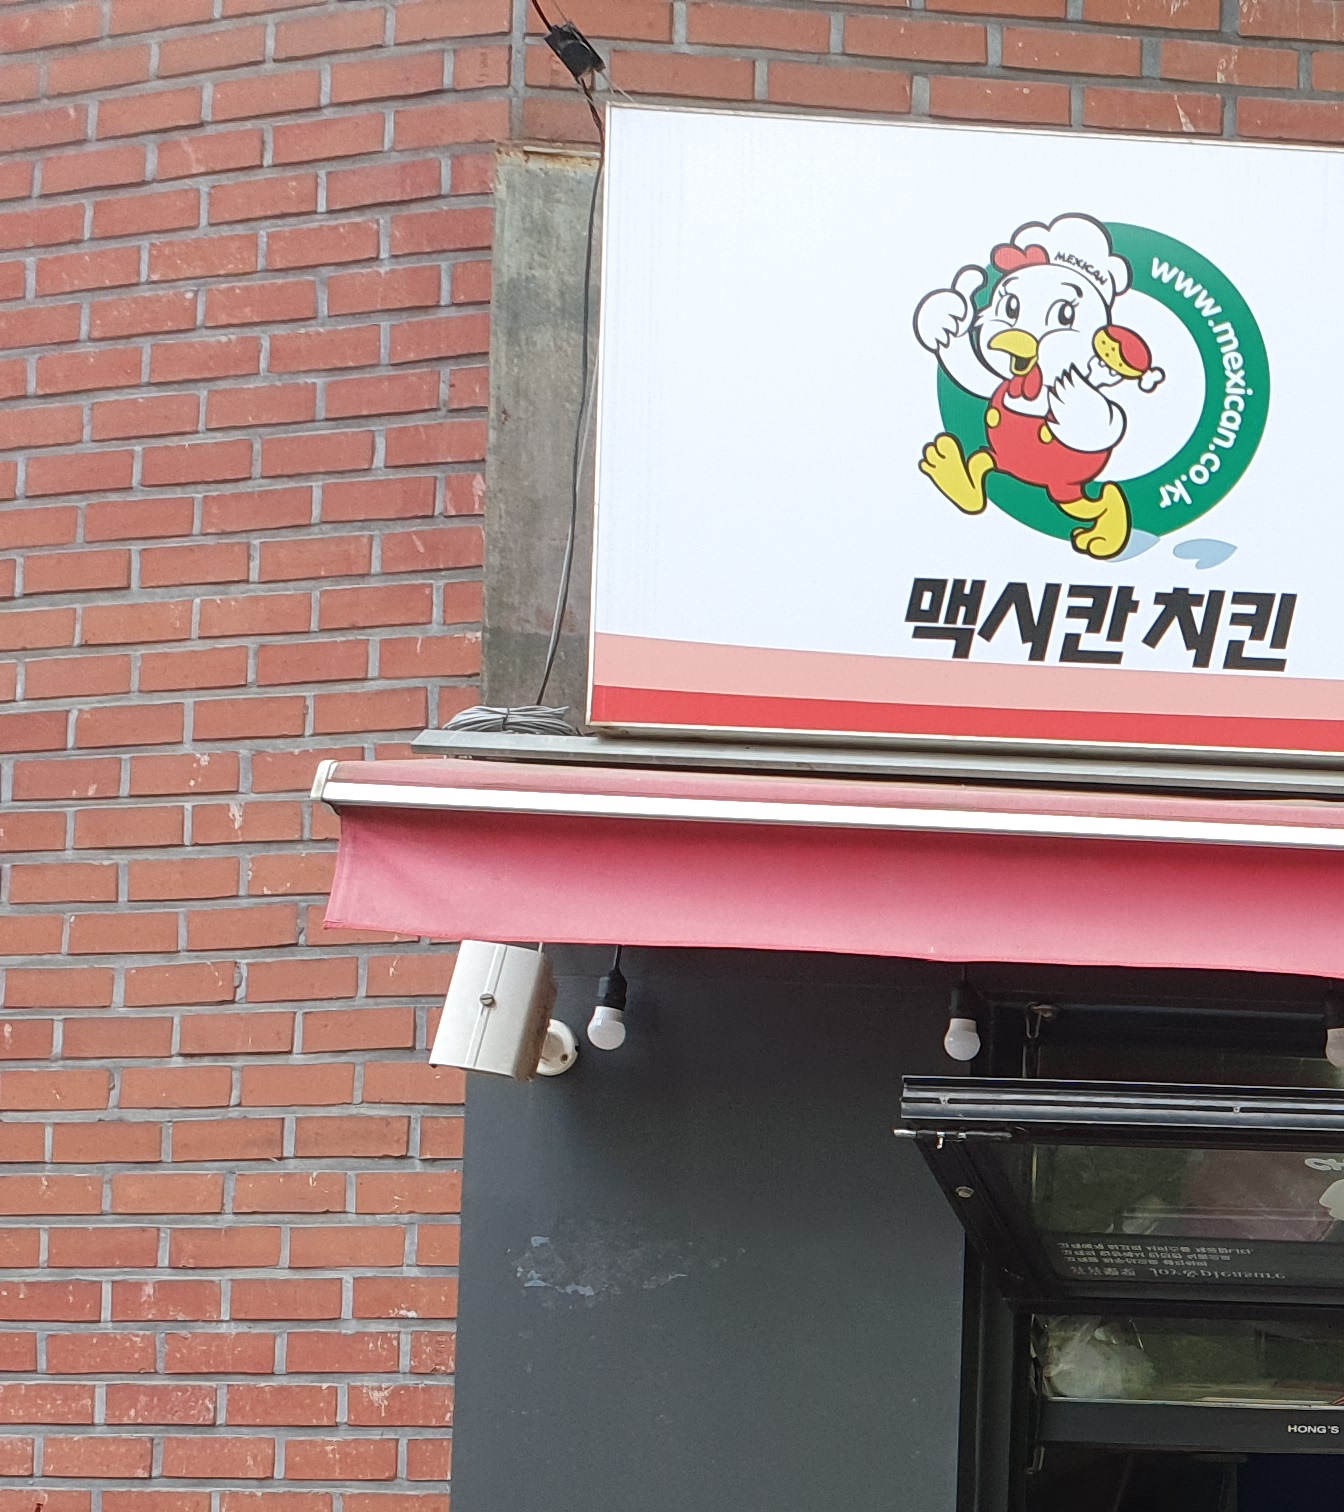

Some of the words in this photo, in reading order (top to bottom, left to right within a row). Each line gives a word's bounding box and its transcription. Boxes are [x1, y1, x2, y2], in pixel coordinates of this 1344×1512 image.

[1055, 251, 1108, 286] MEXICAN
[1150, 256, 1254, 509] www.mexican.co.kr
[1287, 1423, 1340, 1435] HONG'S
